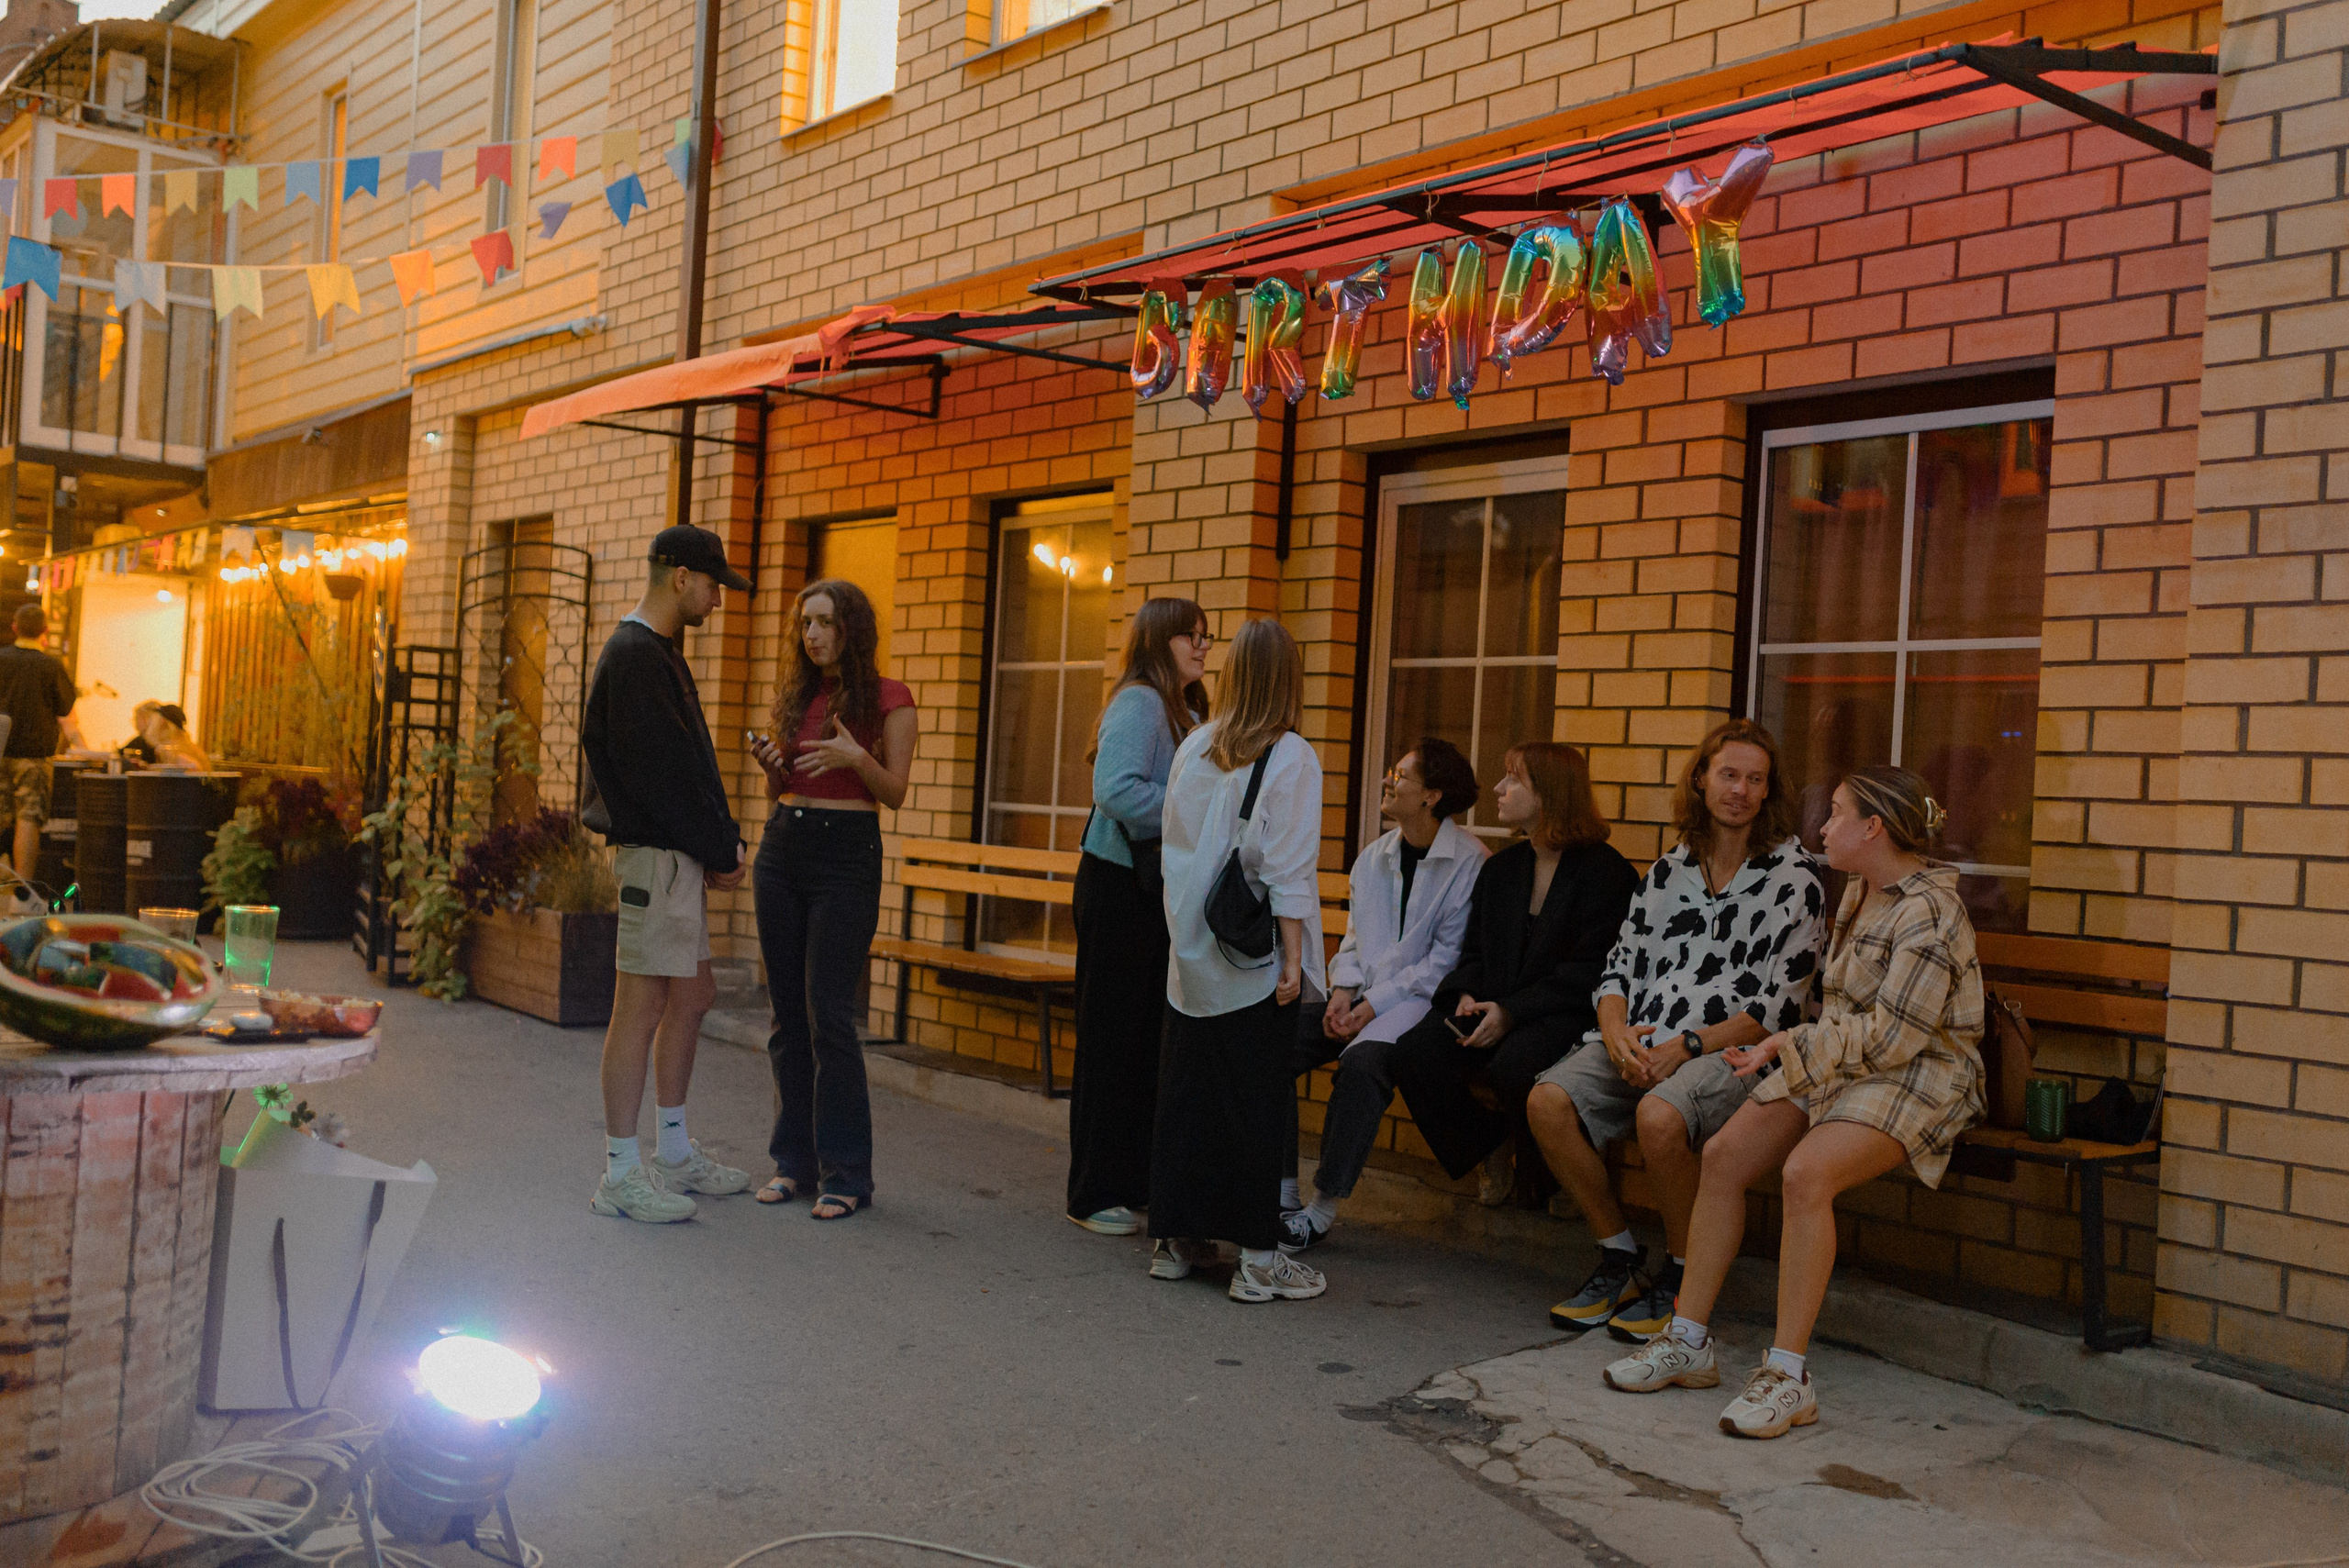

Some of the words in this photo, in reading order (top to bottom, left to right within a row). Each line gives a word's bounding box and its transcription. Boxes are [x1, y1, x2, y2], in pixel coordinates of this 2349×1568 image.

[1130, 141, 1775, 422] BIRTHDAY
[1661, 1353, 1679, 1368] N
[1778, 1392, 1795, 1408] N
